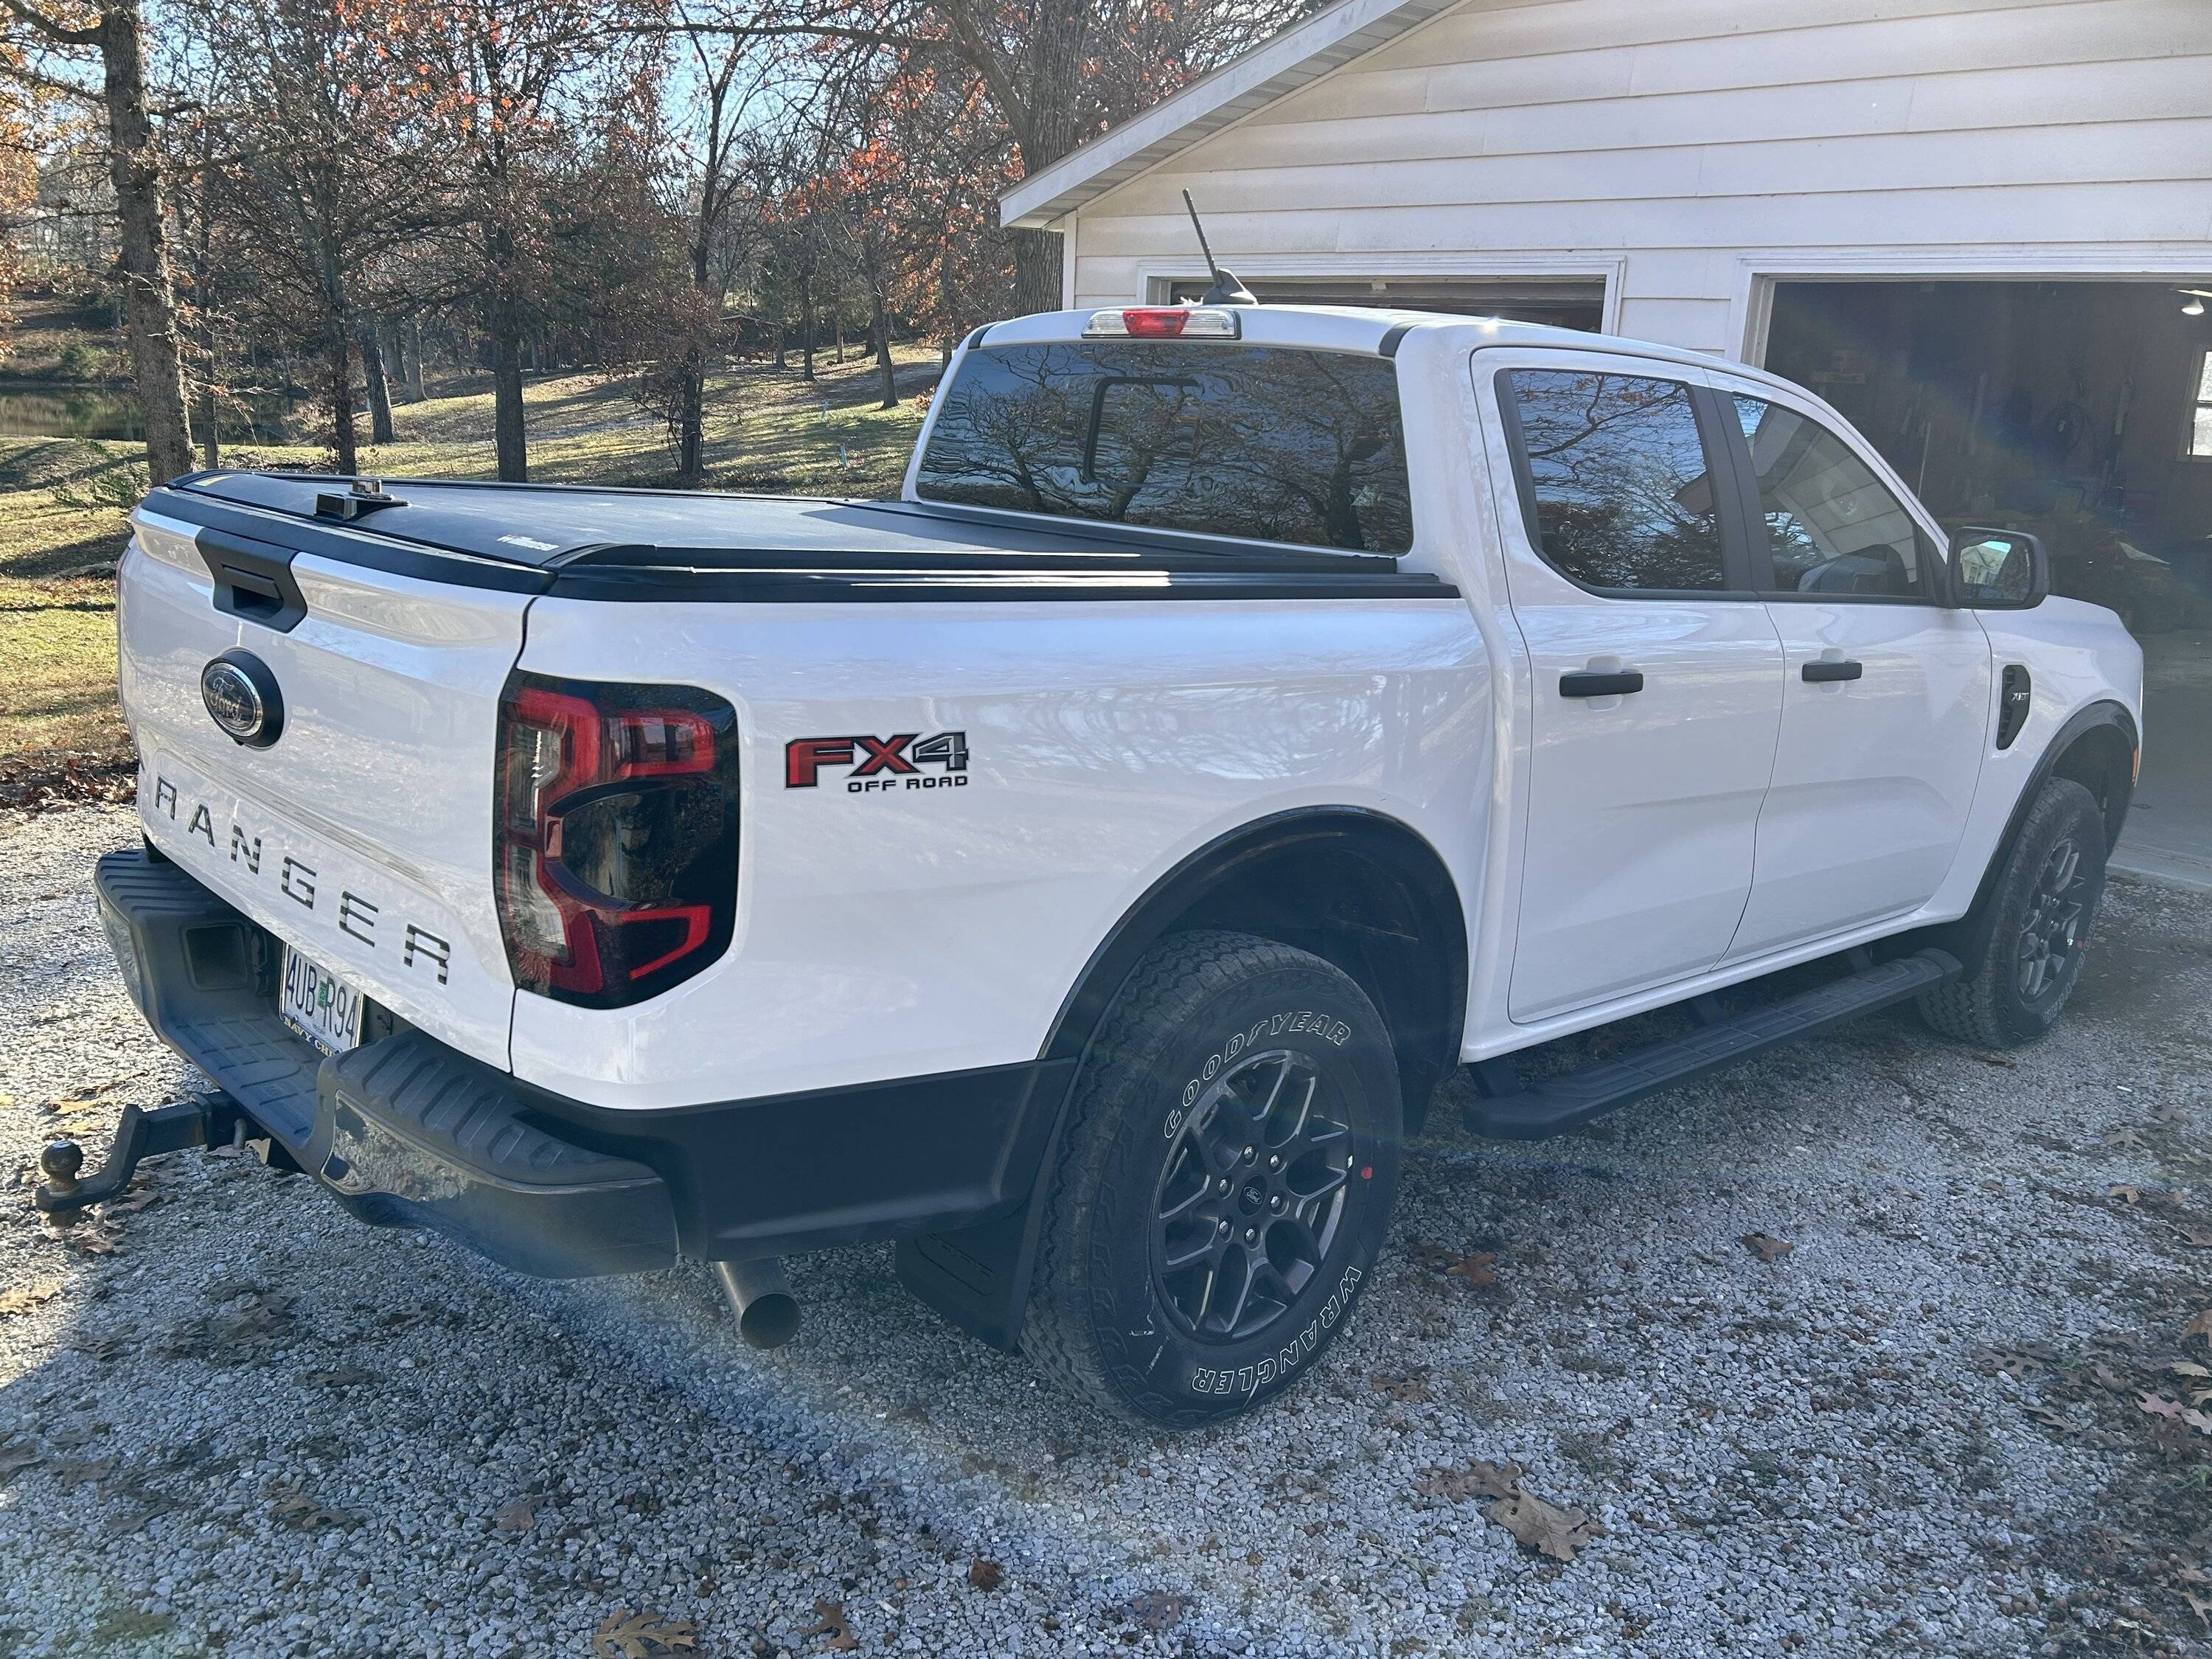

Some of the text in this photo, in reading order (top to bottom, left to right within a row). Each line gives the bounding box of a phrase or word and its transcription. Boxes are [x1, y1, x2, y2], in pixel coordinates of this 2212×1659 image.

[785, 730, 969, 789] FX4
[847, 775, 968, 793] OFF ROAD
[156, 776, 451, 986] RANGER
[323, 975, 358, 1048] R94
[1164, 1011, 1351, 1139] GOODYEAR
[1191, 1265, 1361, 1395] WRANGLER
